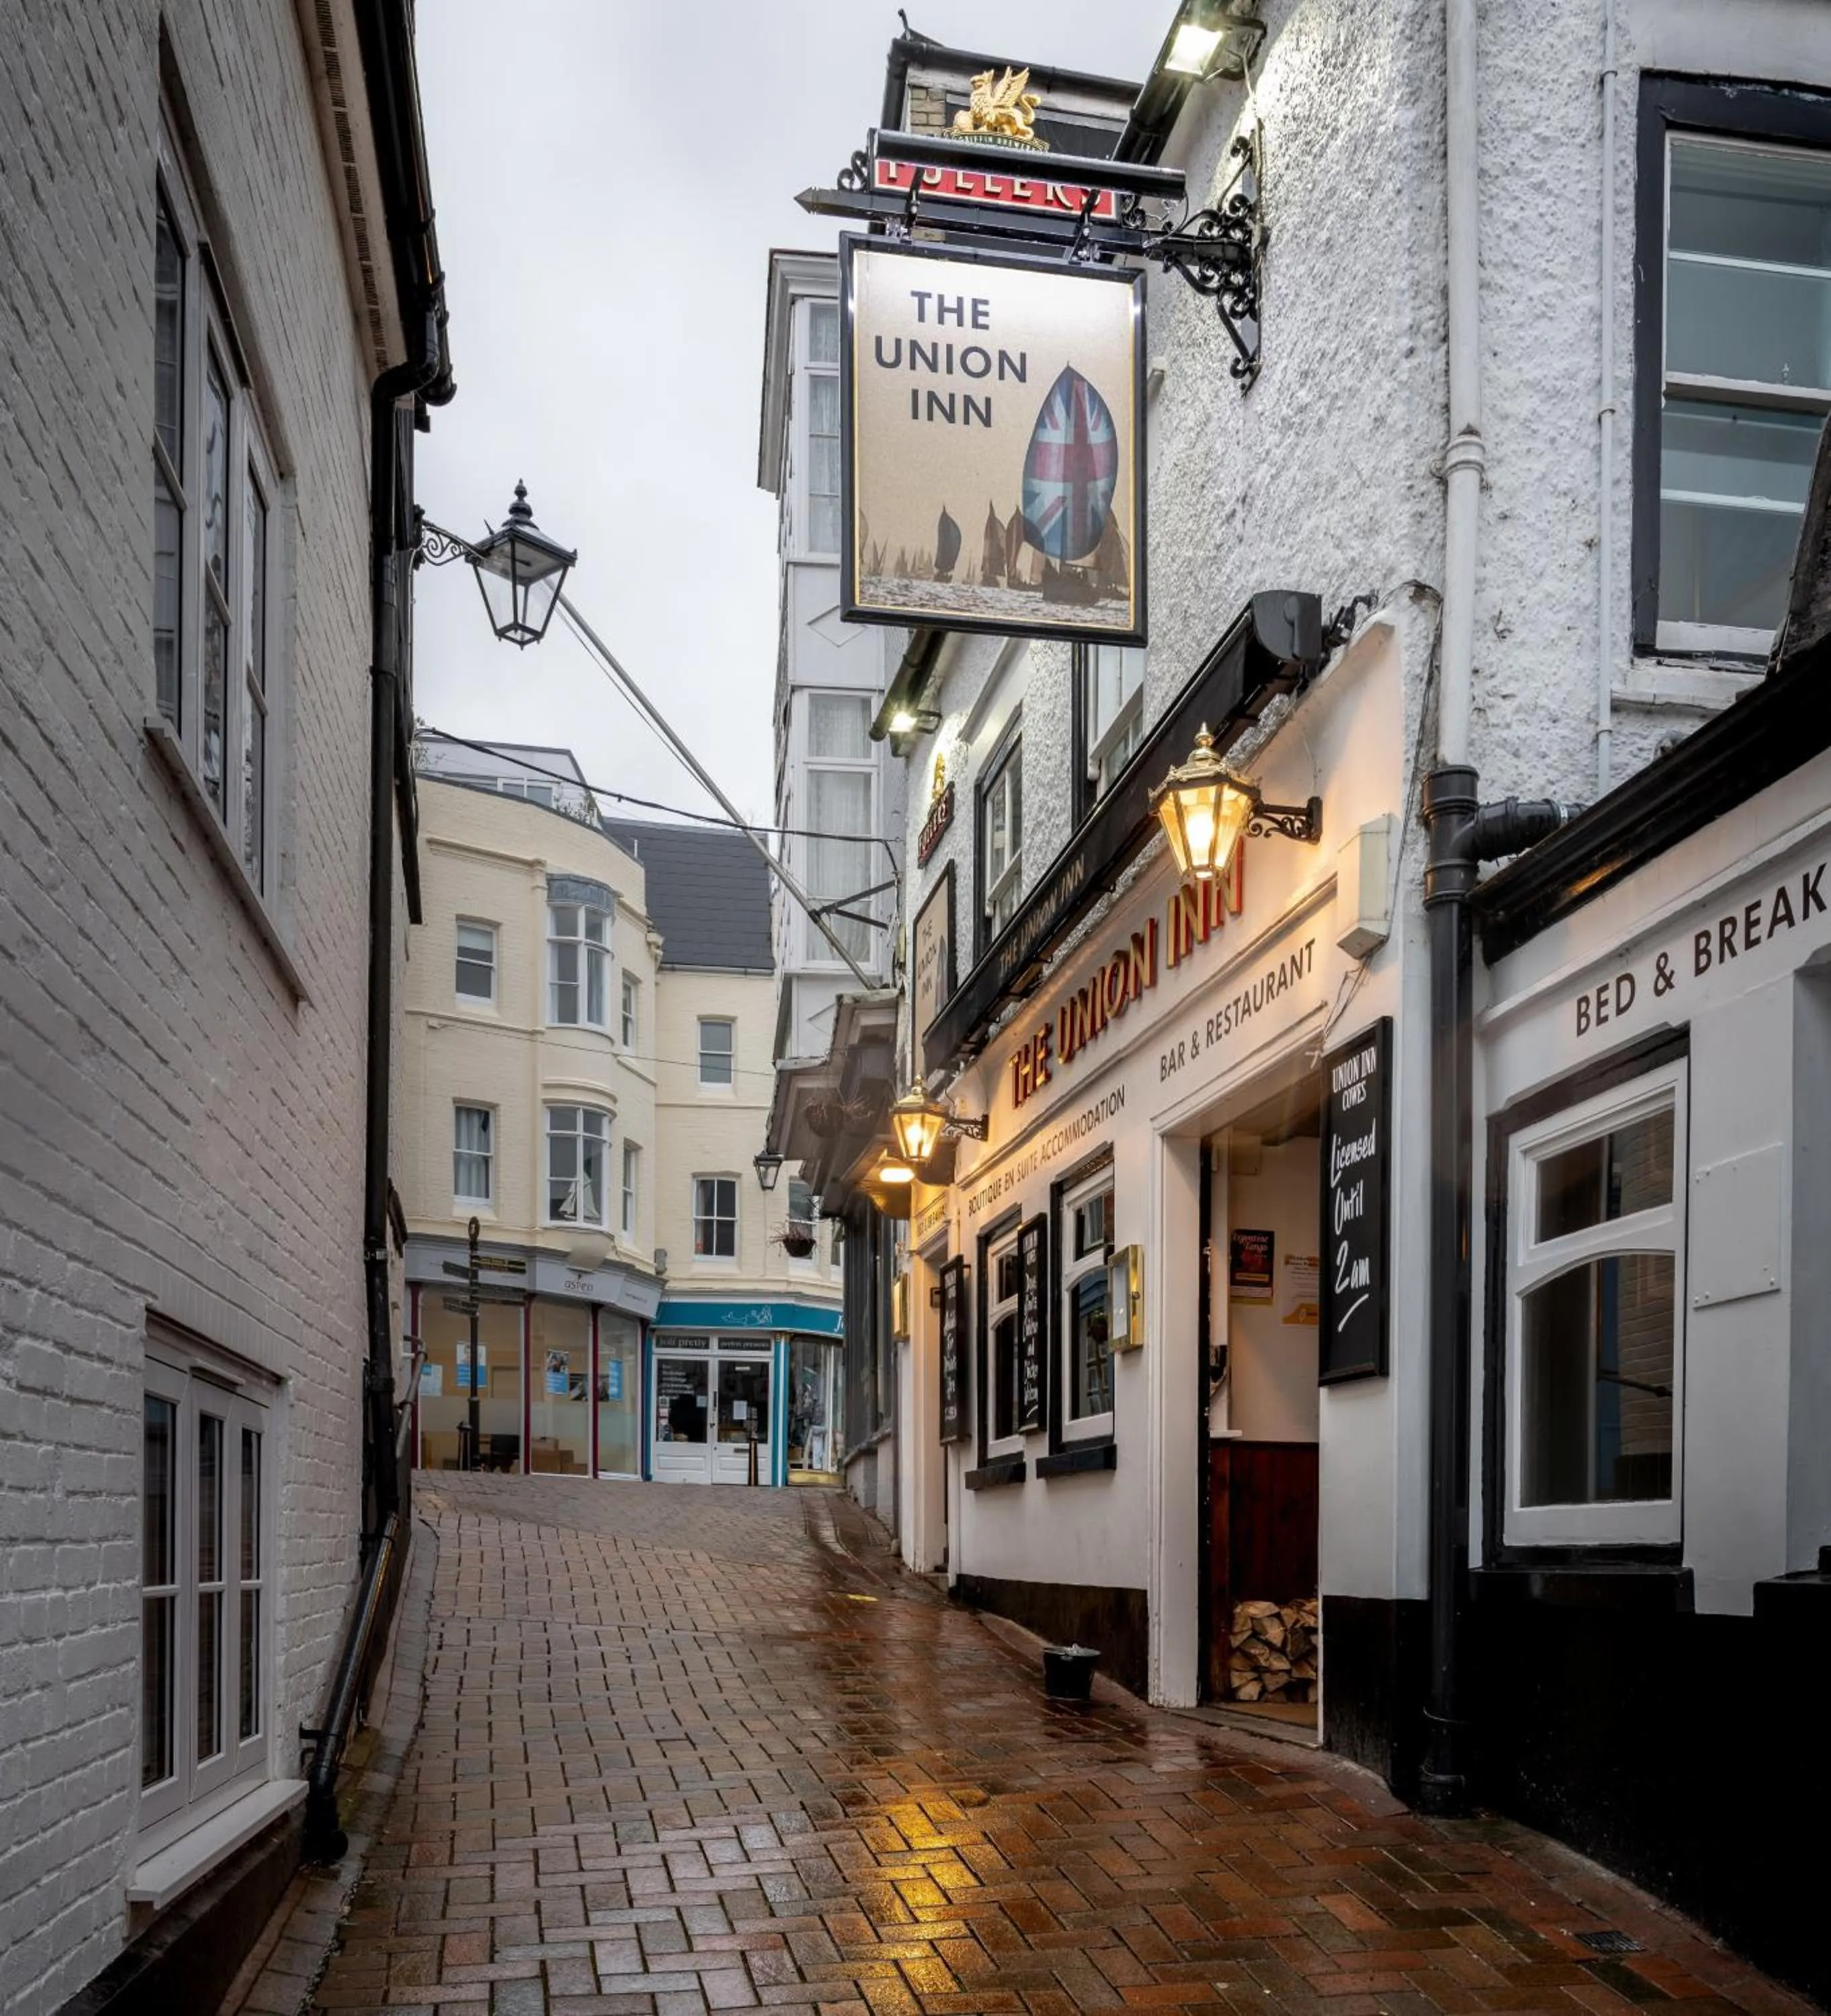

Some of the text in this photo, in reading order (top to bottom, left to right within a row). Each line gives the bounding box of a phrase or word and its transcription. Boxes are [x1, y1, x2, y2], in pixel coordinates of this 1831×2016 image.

[910, 290, 990, 330] THE
[874, 335, 1027, 383] UNION
[911, 388, 992, 427] INN
[1000, 853, 1084, 978] THE UNION INN
[1009, 835, 1244, 1108] THE UNION INN
[1576, 862, 1828, 1038] BED & BREAK
[1160, 937, 1315, 1083] BAR & RESTAURANT
[1332, 1046, 1377, 1093] UNION INN
[1342, 1080, 1367, 1111] COWES
[969, 1084, 1125, 1217] BOUTIQUE EN SUITE ACCOMMODATION
[1331, 1118, 1376, 1189] Licensed
[1334, 1179, 1364, 1236] Until
